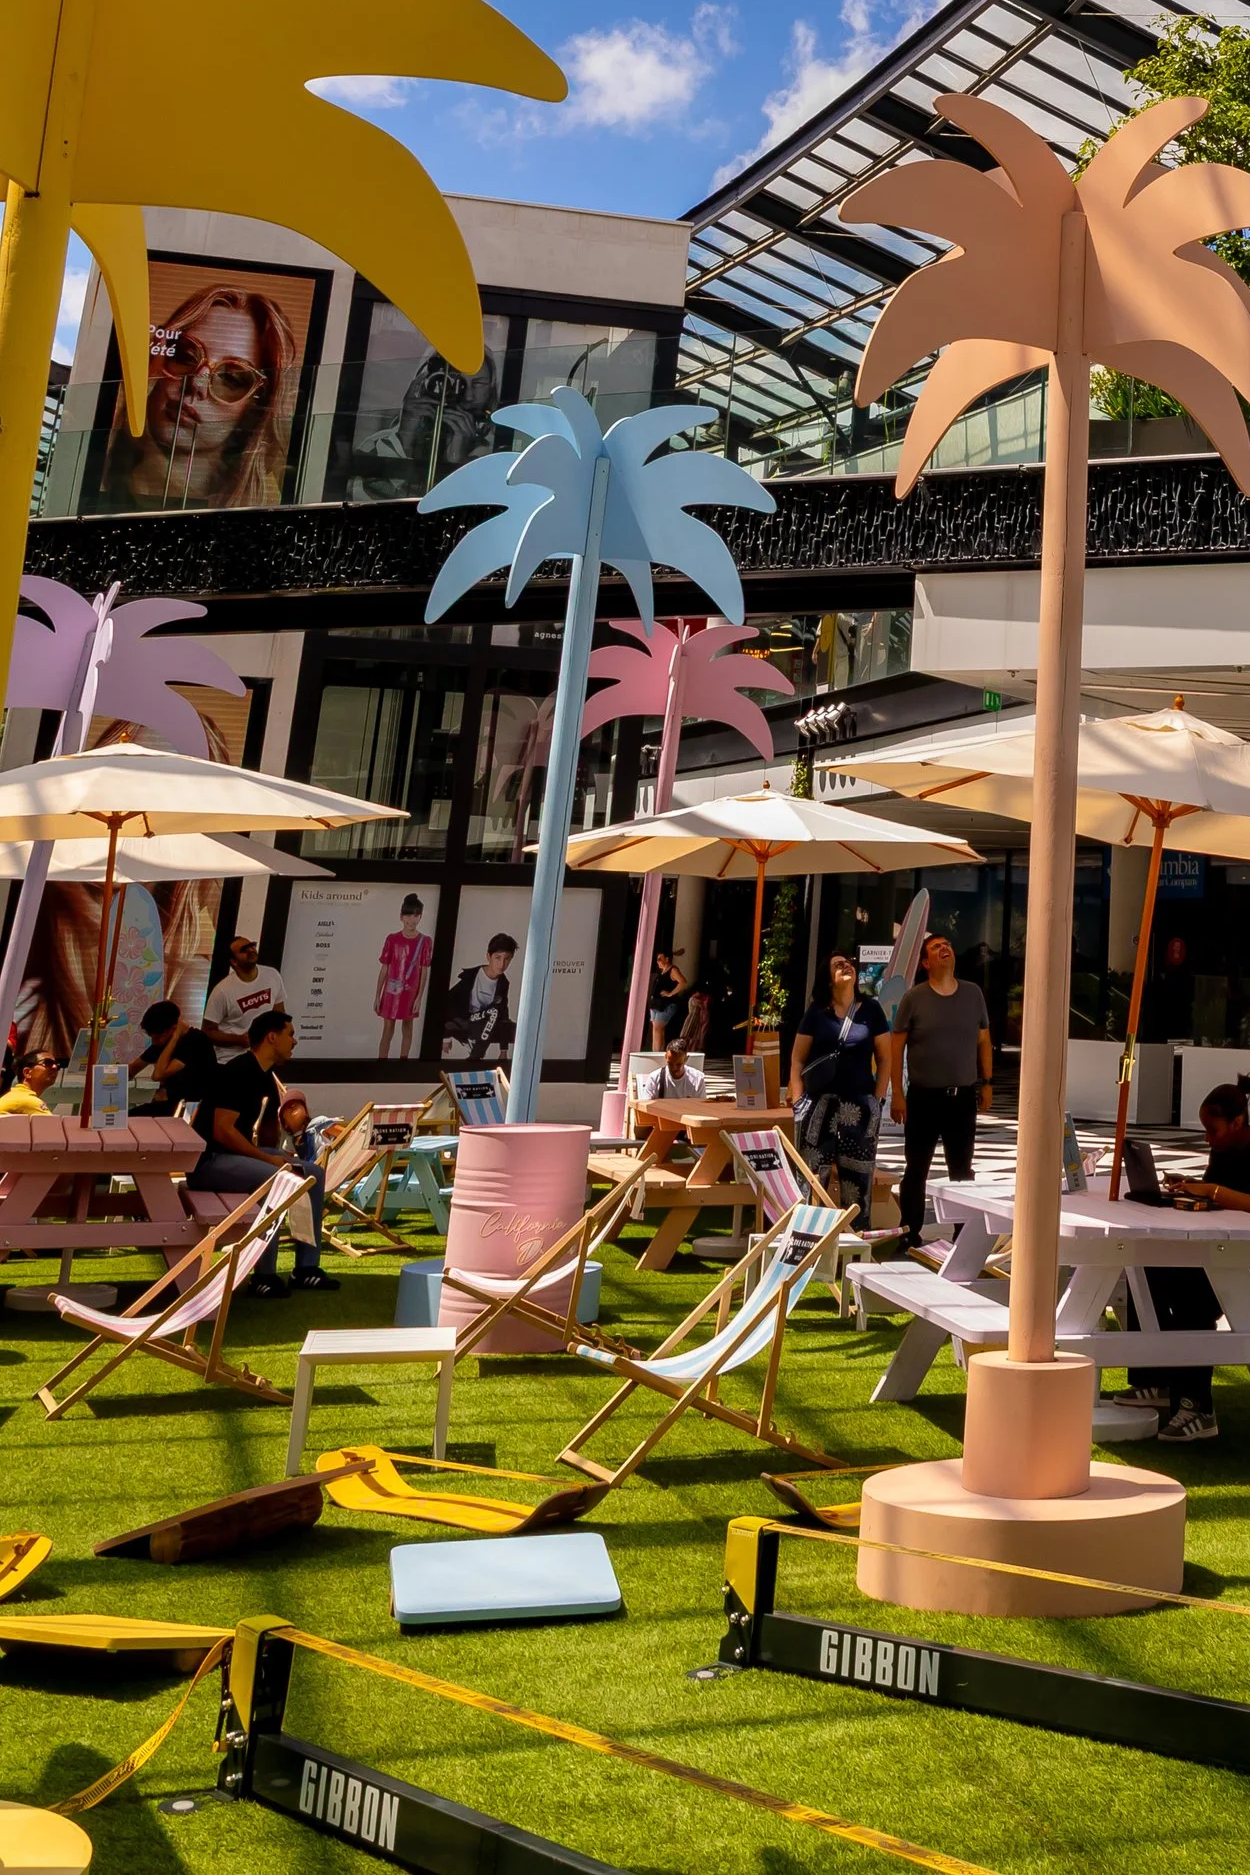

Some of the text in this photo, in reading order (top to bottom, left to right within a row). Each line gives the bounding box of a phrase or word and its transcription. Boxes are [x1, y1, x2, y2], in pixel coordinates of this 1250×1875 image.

[149, 342, 176, 357] 'été
[301, 890, 324, 900] Kids
[820, 1629, 950, 1697] GIBBON
[299, 1759, 400, 1852] GIBBON
